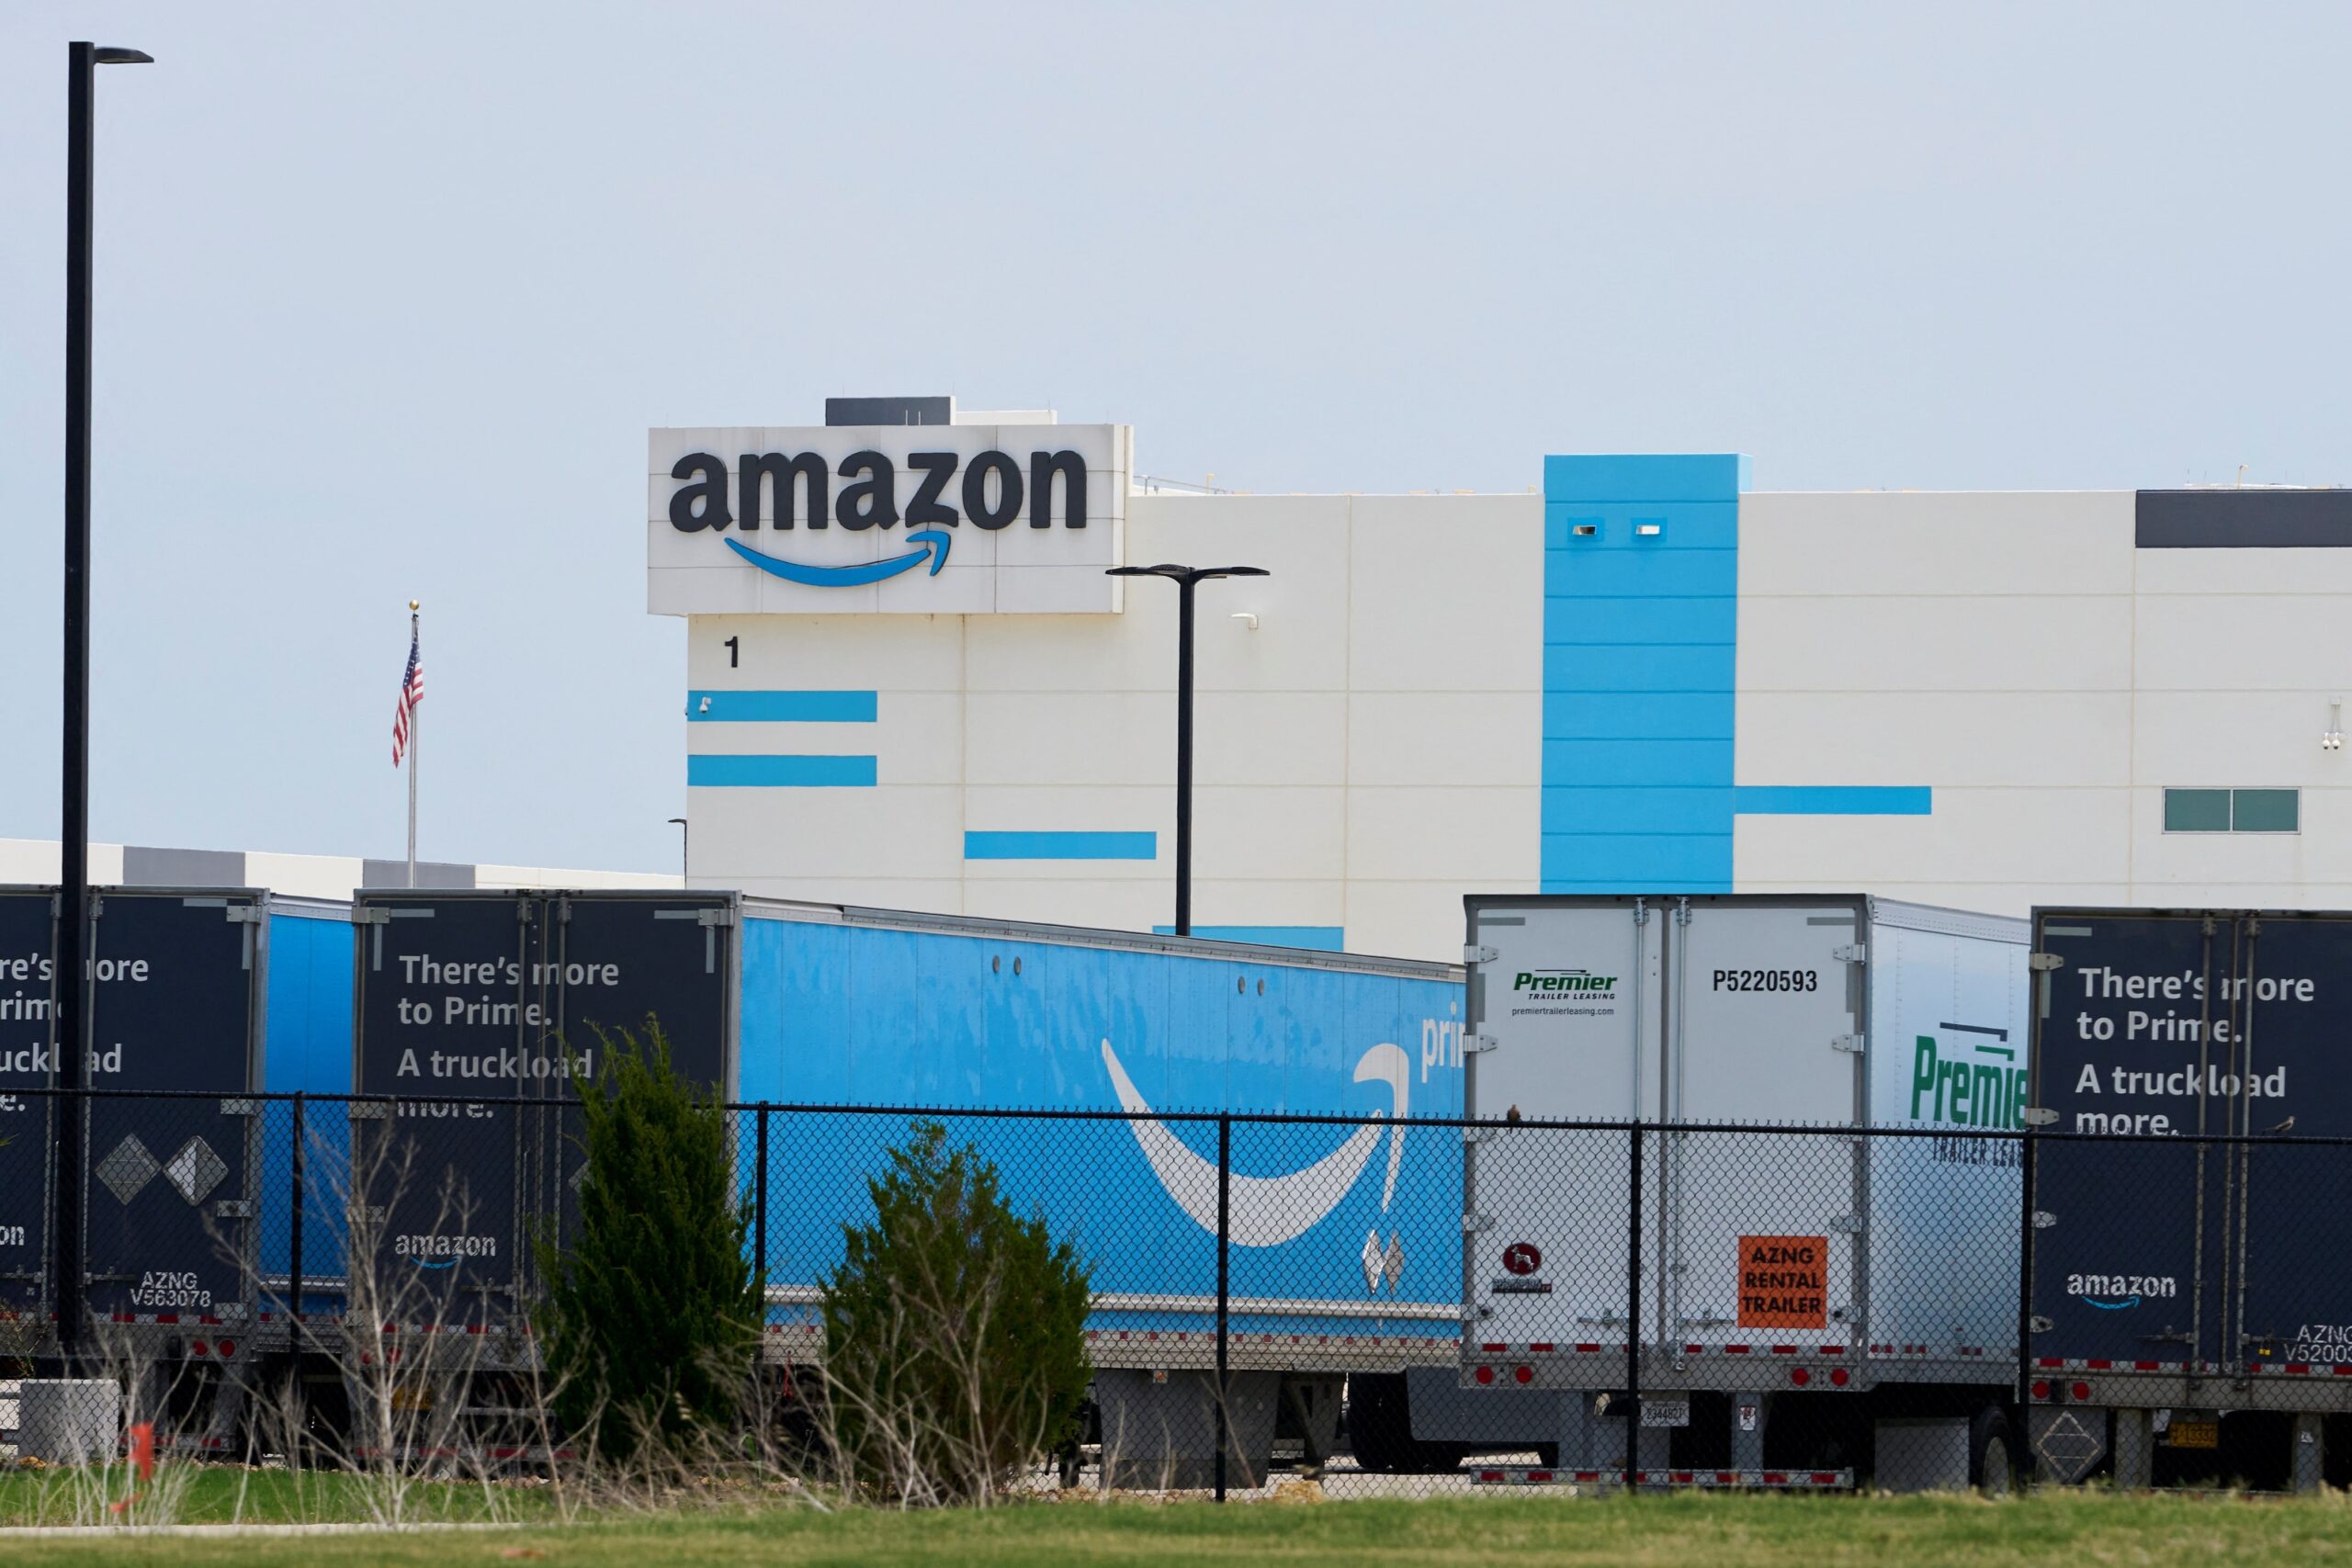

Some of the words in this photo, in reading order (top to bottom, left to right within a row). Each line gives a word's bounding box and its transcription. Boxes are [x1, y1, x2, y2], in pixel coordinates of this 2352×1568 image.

[669, 450, 1087, 533] amazon
[724, 636, 739, 668] 1
[85, 959, 149, 982] ore
[399, 954, 520, 986] There's
[533, 963, 619, 986] more
[1514, 972, 1617, 991] Premier
[1713, 970, 1817, 991] P5220593
[2077, 966, 2204, 999] There's
[0, 990, 62, 1021] rim
[398, 998, 433, 1025] to
[445, 995, 552, 1026] Prime.
[1511, 1007, 1614, 1017] premiertrailerleasing.com
[2076, 1011, 2114, 1040] to
[2127, 1010, 2242, 1043] Prime.
[0, 1042, 122, 1072] ucklad
[397, 1048, 421, 1077] A
[430, 1048, 593, 1078] truckload
[1910, 1035, 2028, 1130] Premie
[2075, 1064, 2101, 1094] A
[2111, 1064, 2286, 1098] truckload
[395, 1235, 496, 1257] amazon
[1751, 1247, 1815, 1265] AZNG
[141, 1271, 198, 1290] AZNG
[1746, 1272, 1821, 1289] RENTAL
[2067, 1273, 2177, 1297] amazon
[130, 1289, 211, 1307] V563078
[1742, 1296, 1821, 1314] TRAILER
